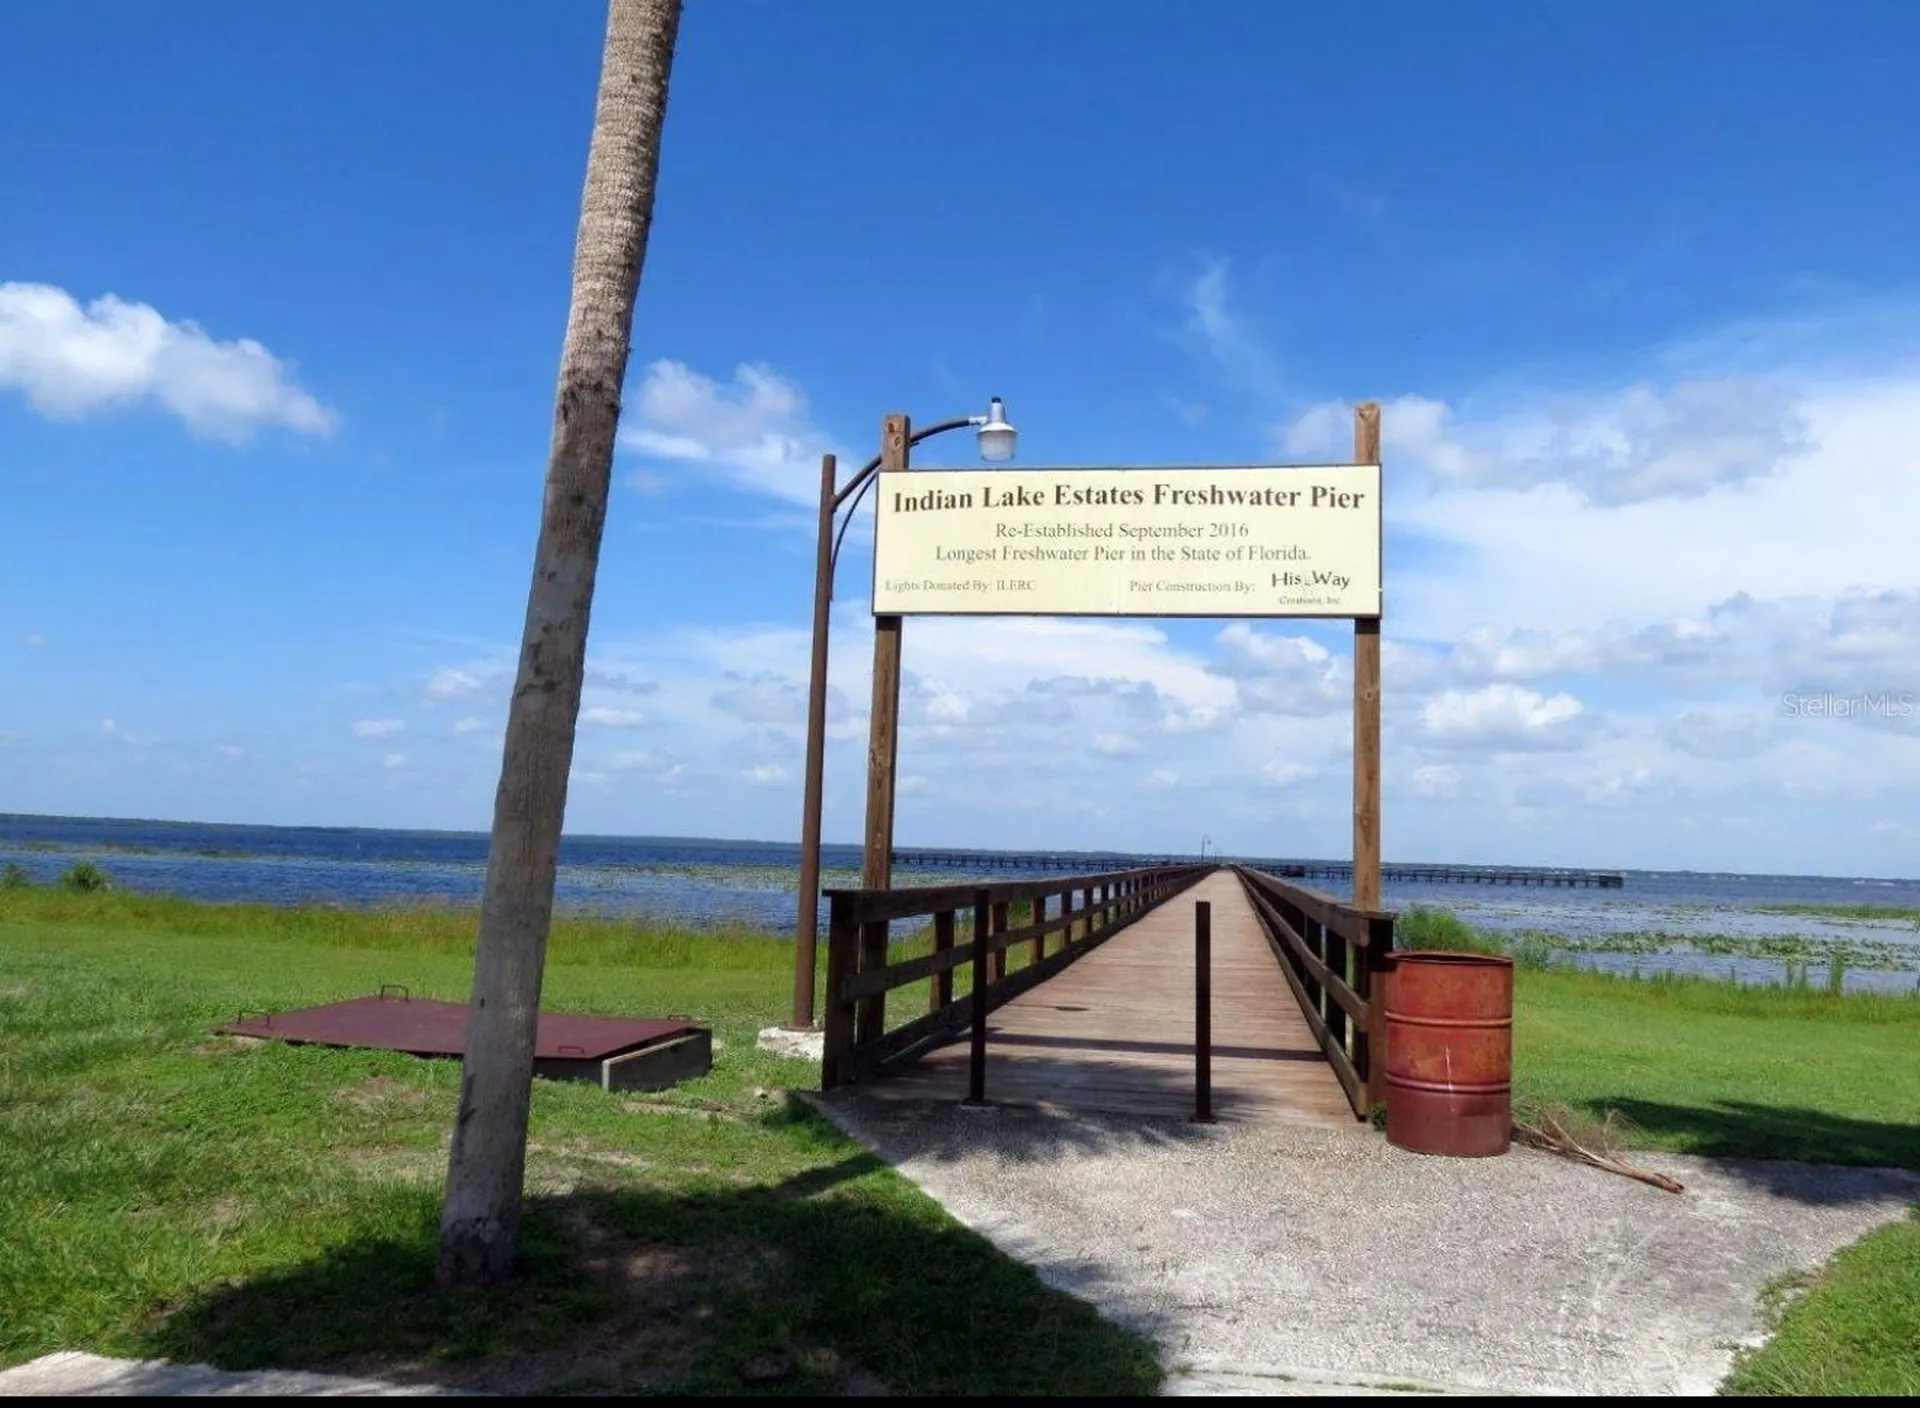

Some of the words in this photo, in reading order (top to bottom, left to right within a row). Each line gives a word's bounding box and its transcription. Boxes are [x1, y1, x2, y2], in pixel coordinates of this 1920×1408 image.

[894, 489, 972, 513] Indian
[982, 485, 1045, 508] Lake
[1054, 484, 1144, 505] Estates
[1153, 484, 1301, 506] Freshwater
[1311, 485, 1365, 509] Pier
[996, 523, 1113, 538] Re-Established
[1119, 523, 1204, 541] September
[1209, 523, 1249, 538] 2016
[936, 546, 997, 564] Longest
[1002, 546, 1088, 561] Freshwater
[1094, 546, 1125, 561] Pier
[1131, 547, 1146, 561] in
[1151, 546, 1175, 561] the
[1181, 546, 1222, 561] State
[1226, 545, 1243, 561] of
[1248, 545, 1311, 561] Florida.
[886, 580, 920, 593] Lights
[923, 580, 969, 591] Donated
[1129, 580, 1152, 592] Pier
[1156, 580, 1231, 592] Construction
[1235, 581, 1255, 595] By:
[1271, 572, 1301, 588] His
[1311, 570, 1350, 590] Way
